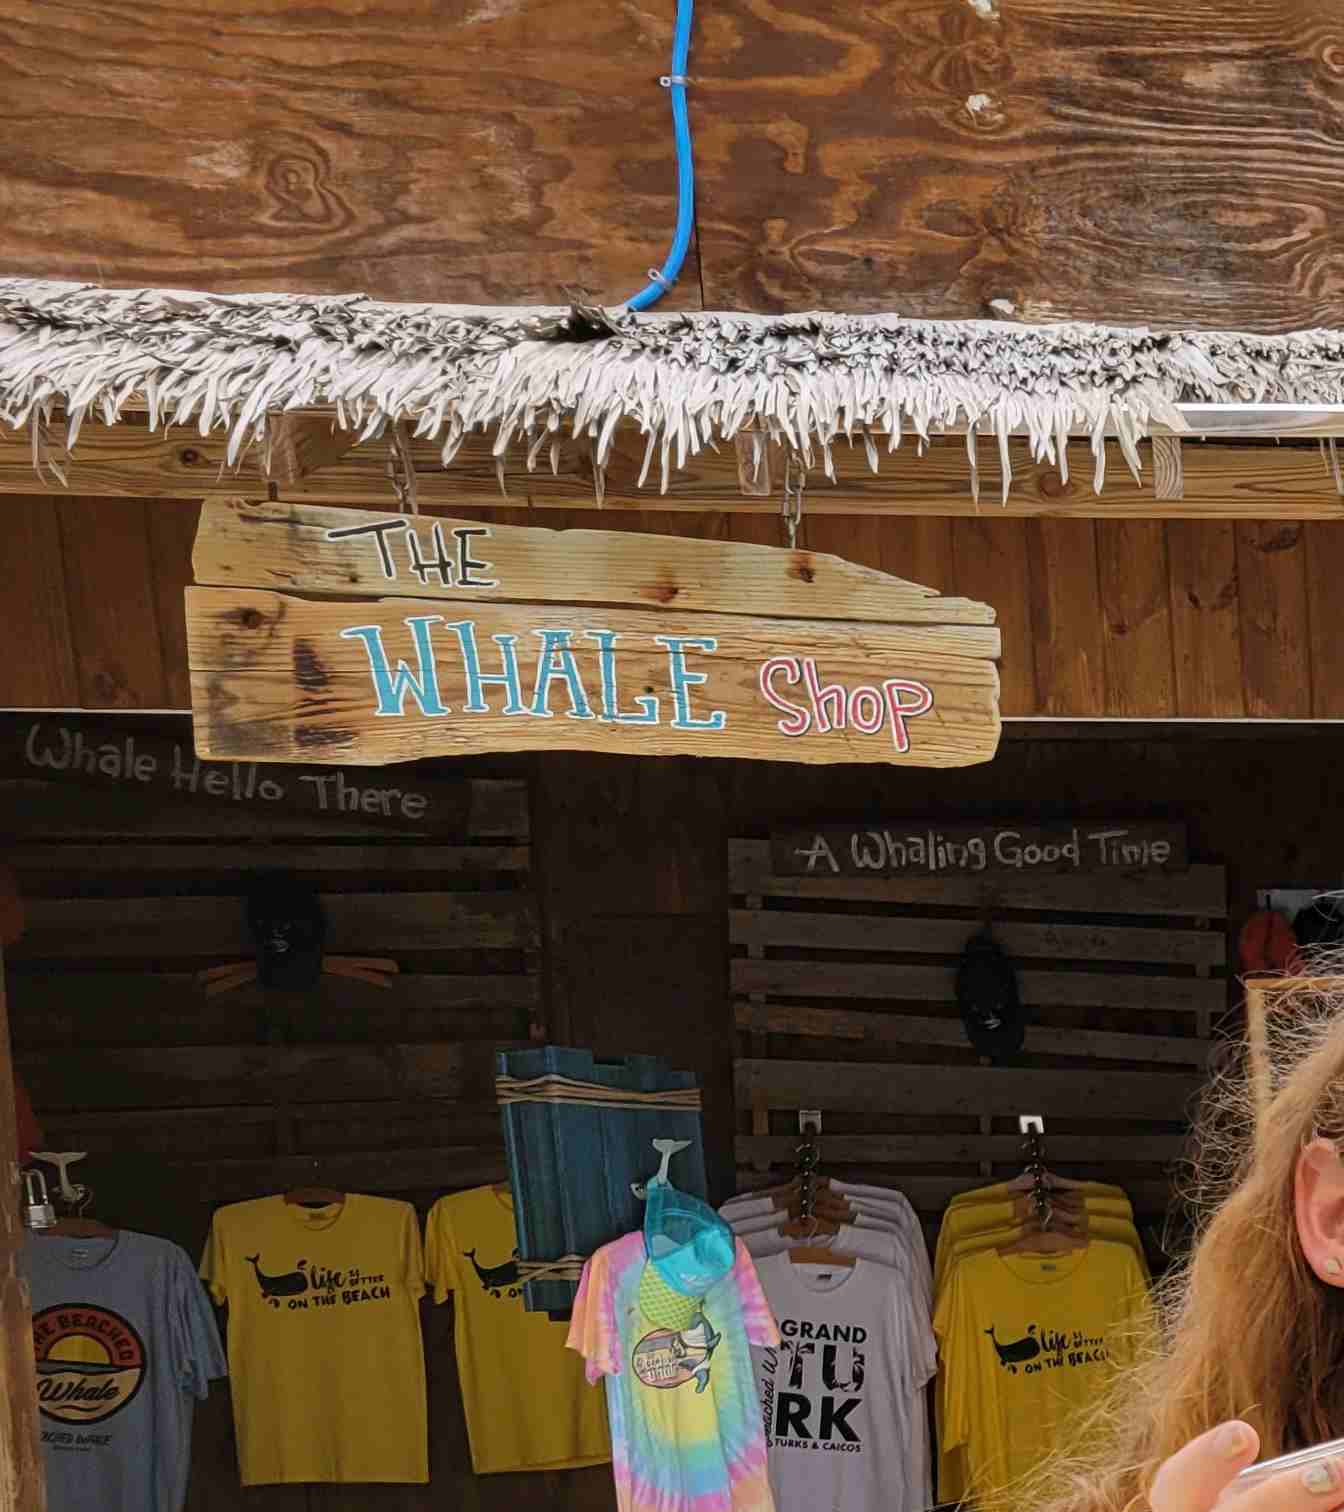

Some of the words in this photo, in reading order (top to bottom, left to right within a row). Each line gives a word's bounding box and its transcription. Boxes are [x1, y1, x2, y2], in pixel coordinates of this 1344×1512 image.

[327, 518, 500, 589] THE
[340, 615, 727, 731] WHALE
[759, 656, 934, 753] Shop
[24, 721, 156, 782] Whale
[173, 742, 285, 802] Hello
[299, 770, 428, 819] There
[795, 834, 840, 872] A
[850, 829, 987, 871] Whaling
[993, 827, 1080, 868] Good
[1087, 829, 1171, 866] Time
[288, 1299, 309, 1310] ON
[312, 1294, 337, 1307] THE
[341, 1284, 391, 1305] BEACH
[56, 1312, 134, 1360] BEACHED
[780, 1319, 867, 1344] GRAND
[37, 1377, 120, 1402] Whale
[1024, 1362, 1042, 1374] ON
[775, 1391, 862, 1443] RK
[775, 1438, 809, 1450] TURKS
[823, 1441, 862, 1453] CAICOS
